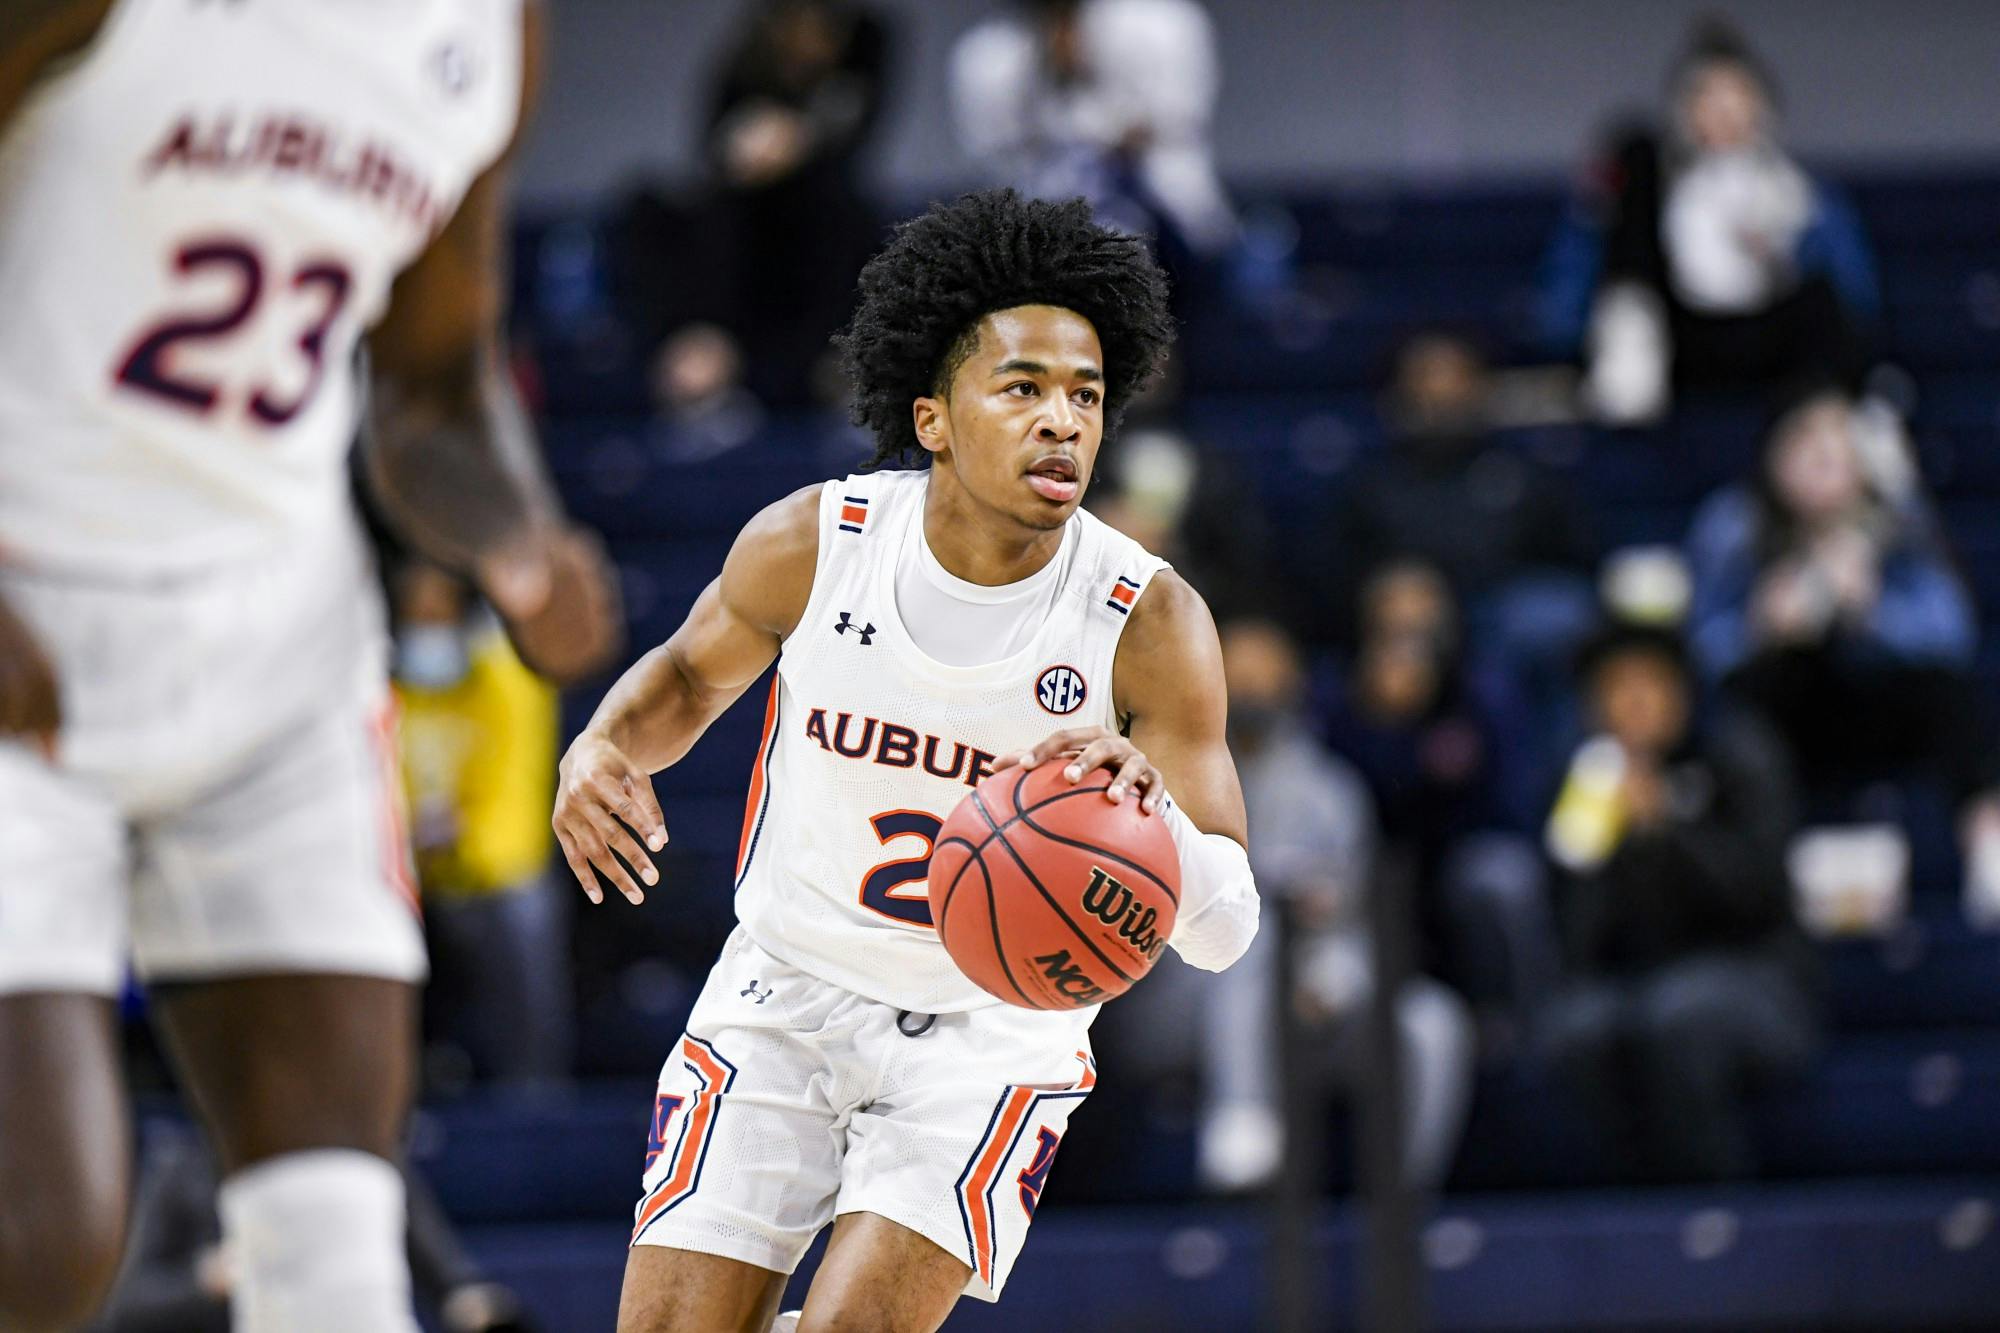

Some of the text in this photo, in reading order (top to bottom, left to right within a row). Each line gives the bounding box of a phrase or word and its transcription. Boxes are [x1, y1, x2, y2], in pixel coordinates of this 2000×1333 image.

[113, 238, 354, 427] 23
[1038, 667, 1085, 713] SEC
[859, 809, 945, 928] 2
[1081, 865, 1167, 963] Wilso
